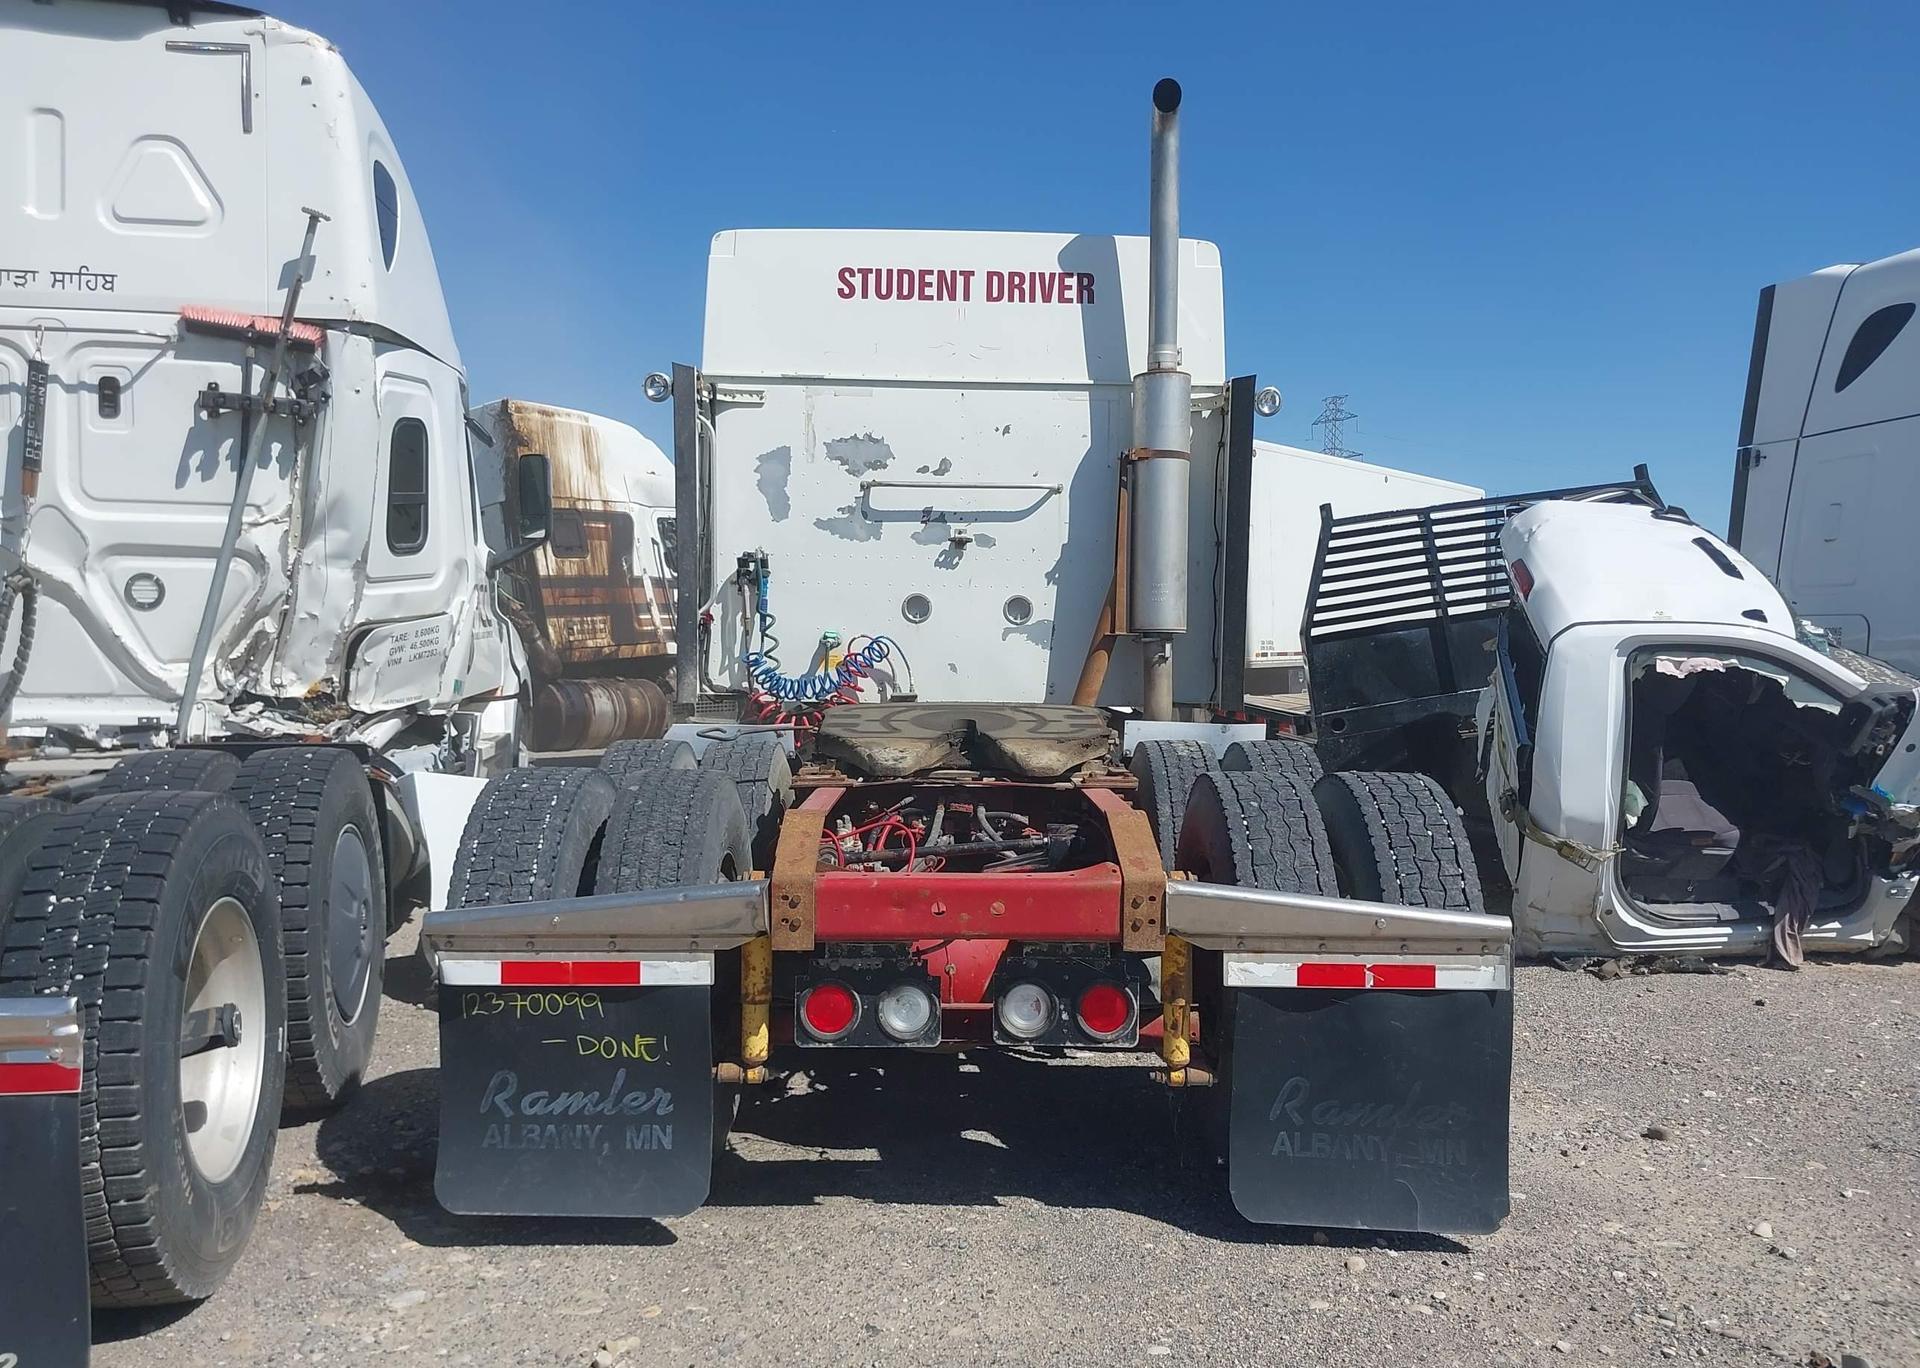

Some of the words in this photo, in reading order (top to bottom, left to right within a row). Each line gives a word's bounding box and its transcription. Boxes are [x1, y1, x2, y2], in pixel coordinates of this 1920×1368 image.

[837, 266, 976, 302] STUDENT
[985, 270, 1096, 305] DRIVER
[462, 992, 605, 1020] 12370099
[577, 1033, 672, 1066] DONE!
[480, 1068, 674, 1118] Ramler
[481, 1123, 611, 1155] ALBANY,
[625, 1123, 673, 1150] MN
